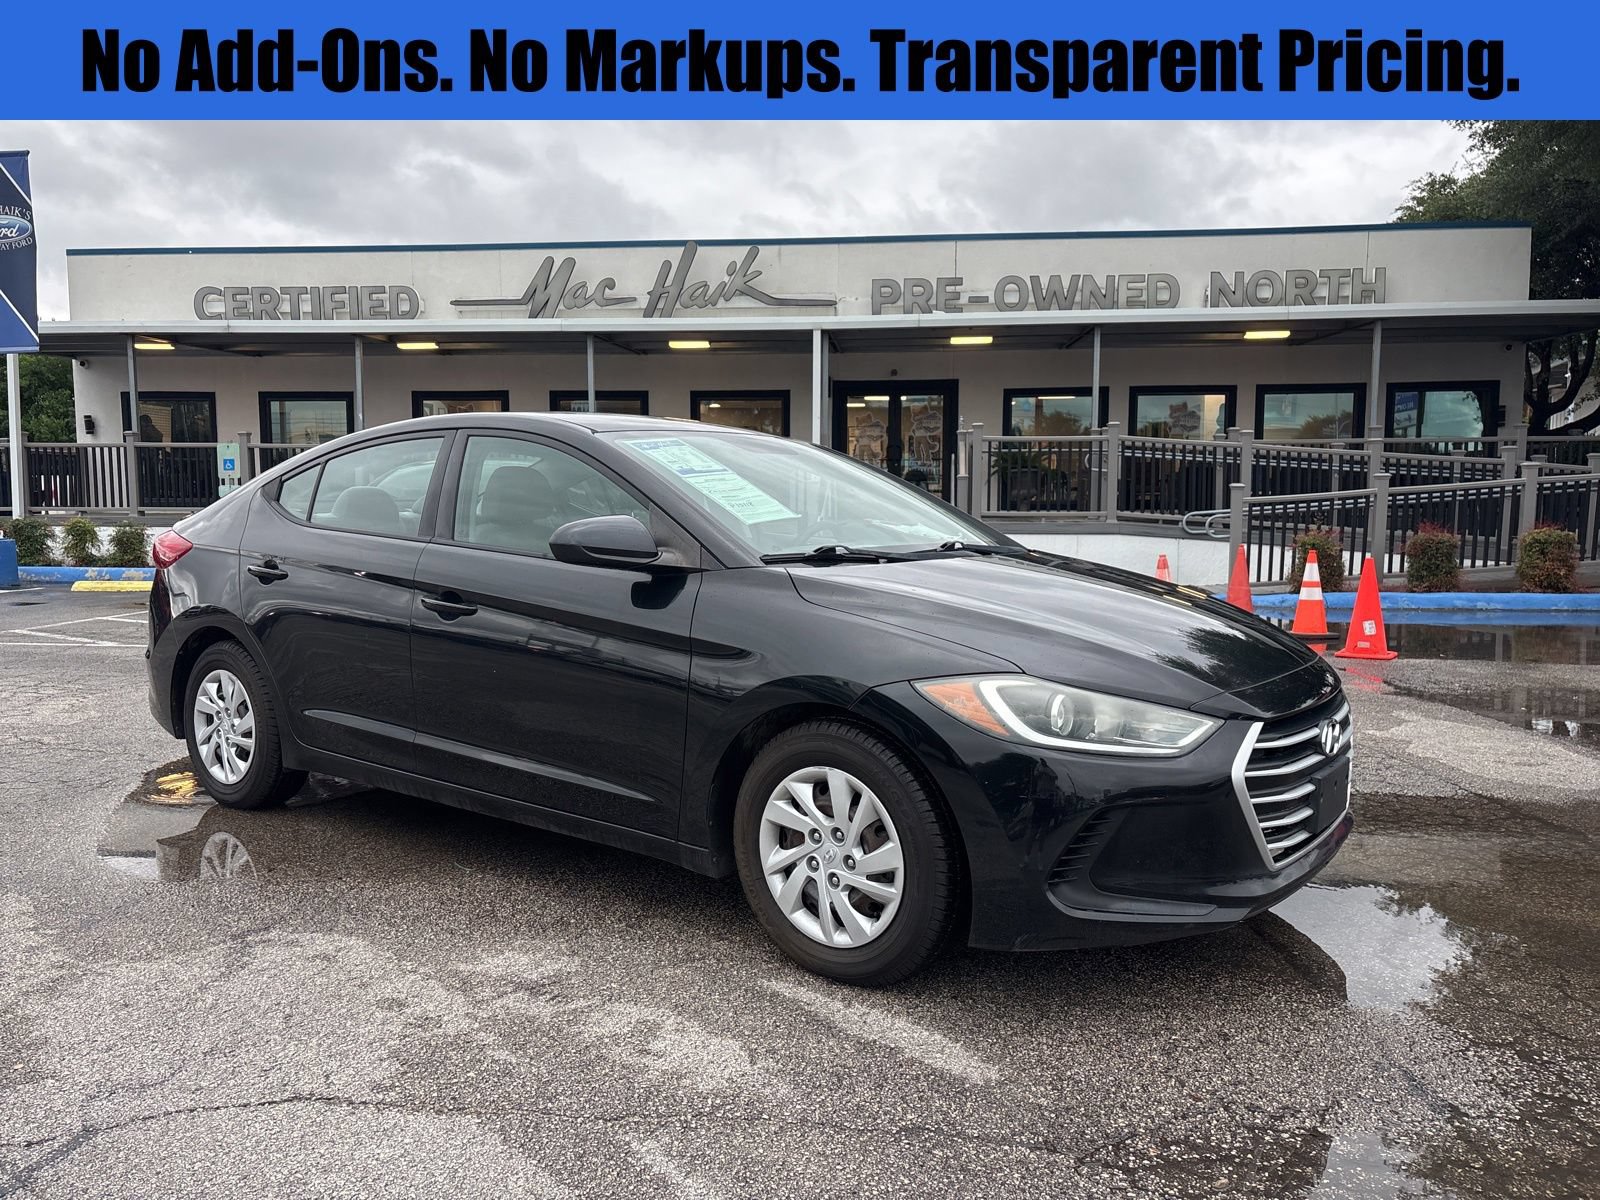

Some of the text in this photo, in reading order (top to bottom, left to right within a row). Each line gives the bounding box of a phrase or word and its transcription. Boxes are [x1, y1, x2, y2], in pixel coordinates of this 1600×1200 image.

[11, 236, 33, 250] FORD
[450, 240, 838, 319] Mac Haik
[871, 266, 1388, 315] PRE-OWNED NORTH
[193, 285, 420, 320] CERTIFIED
